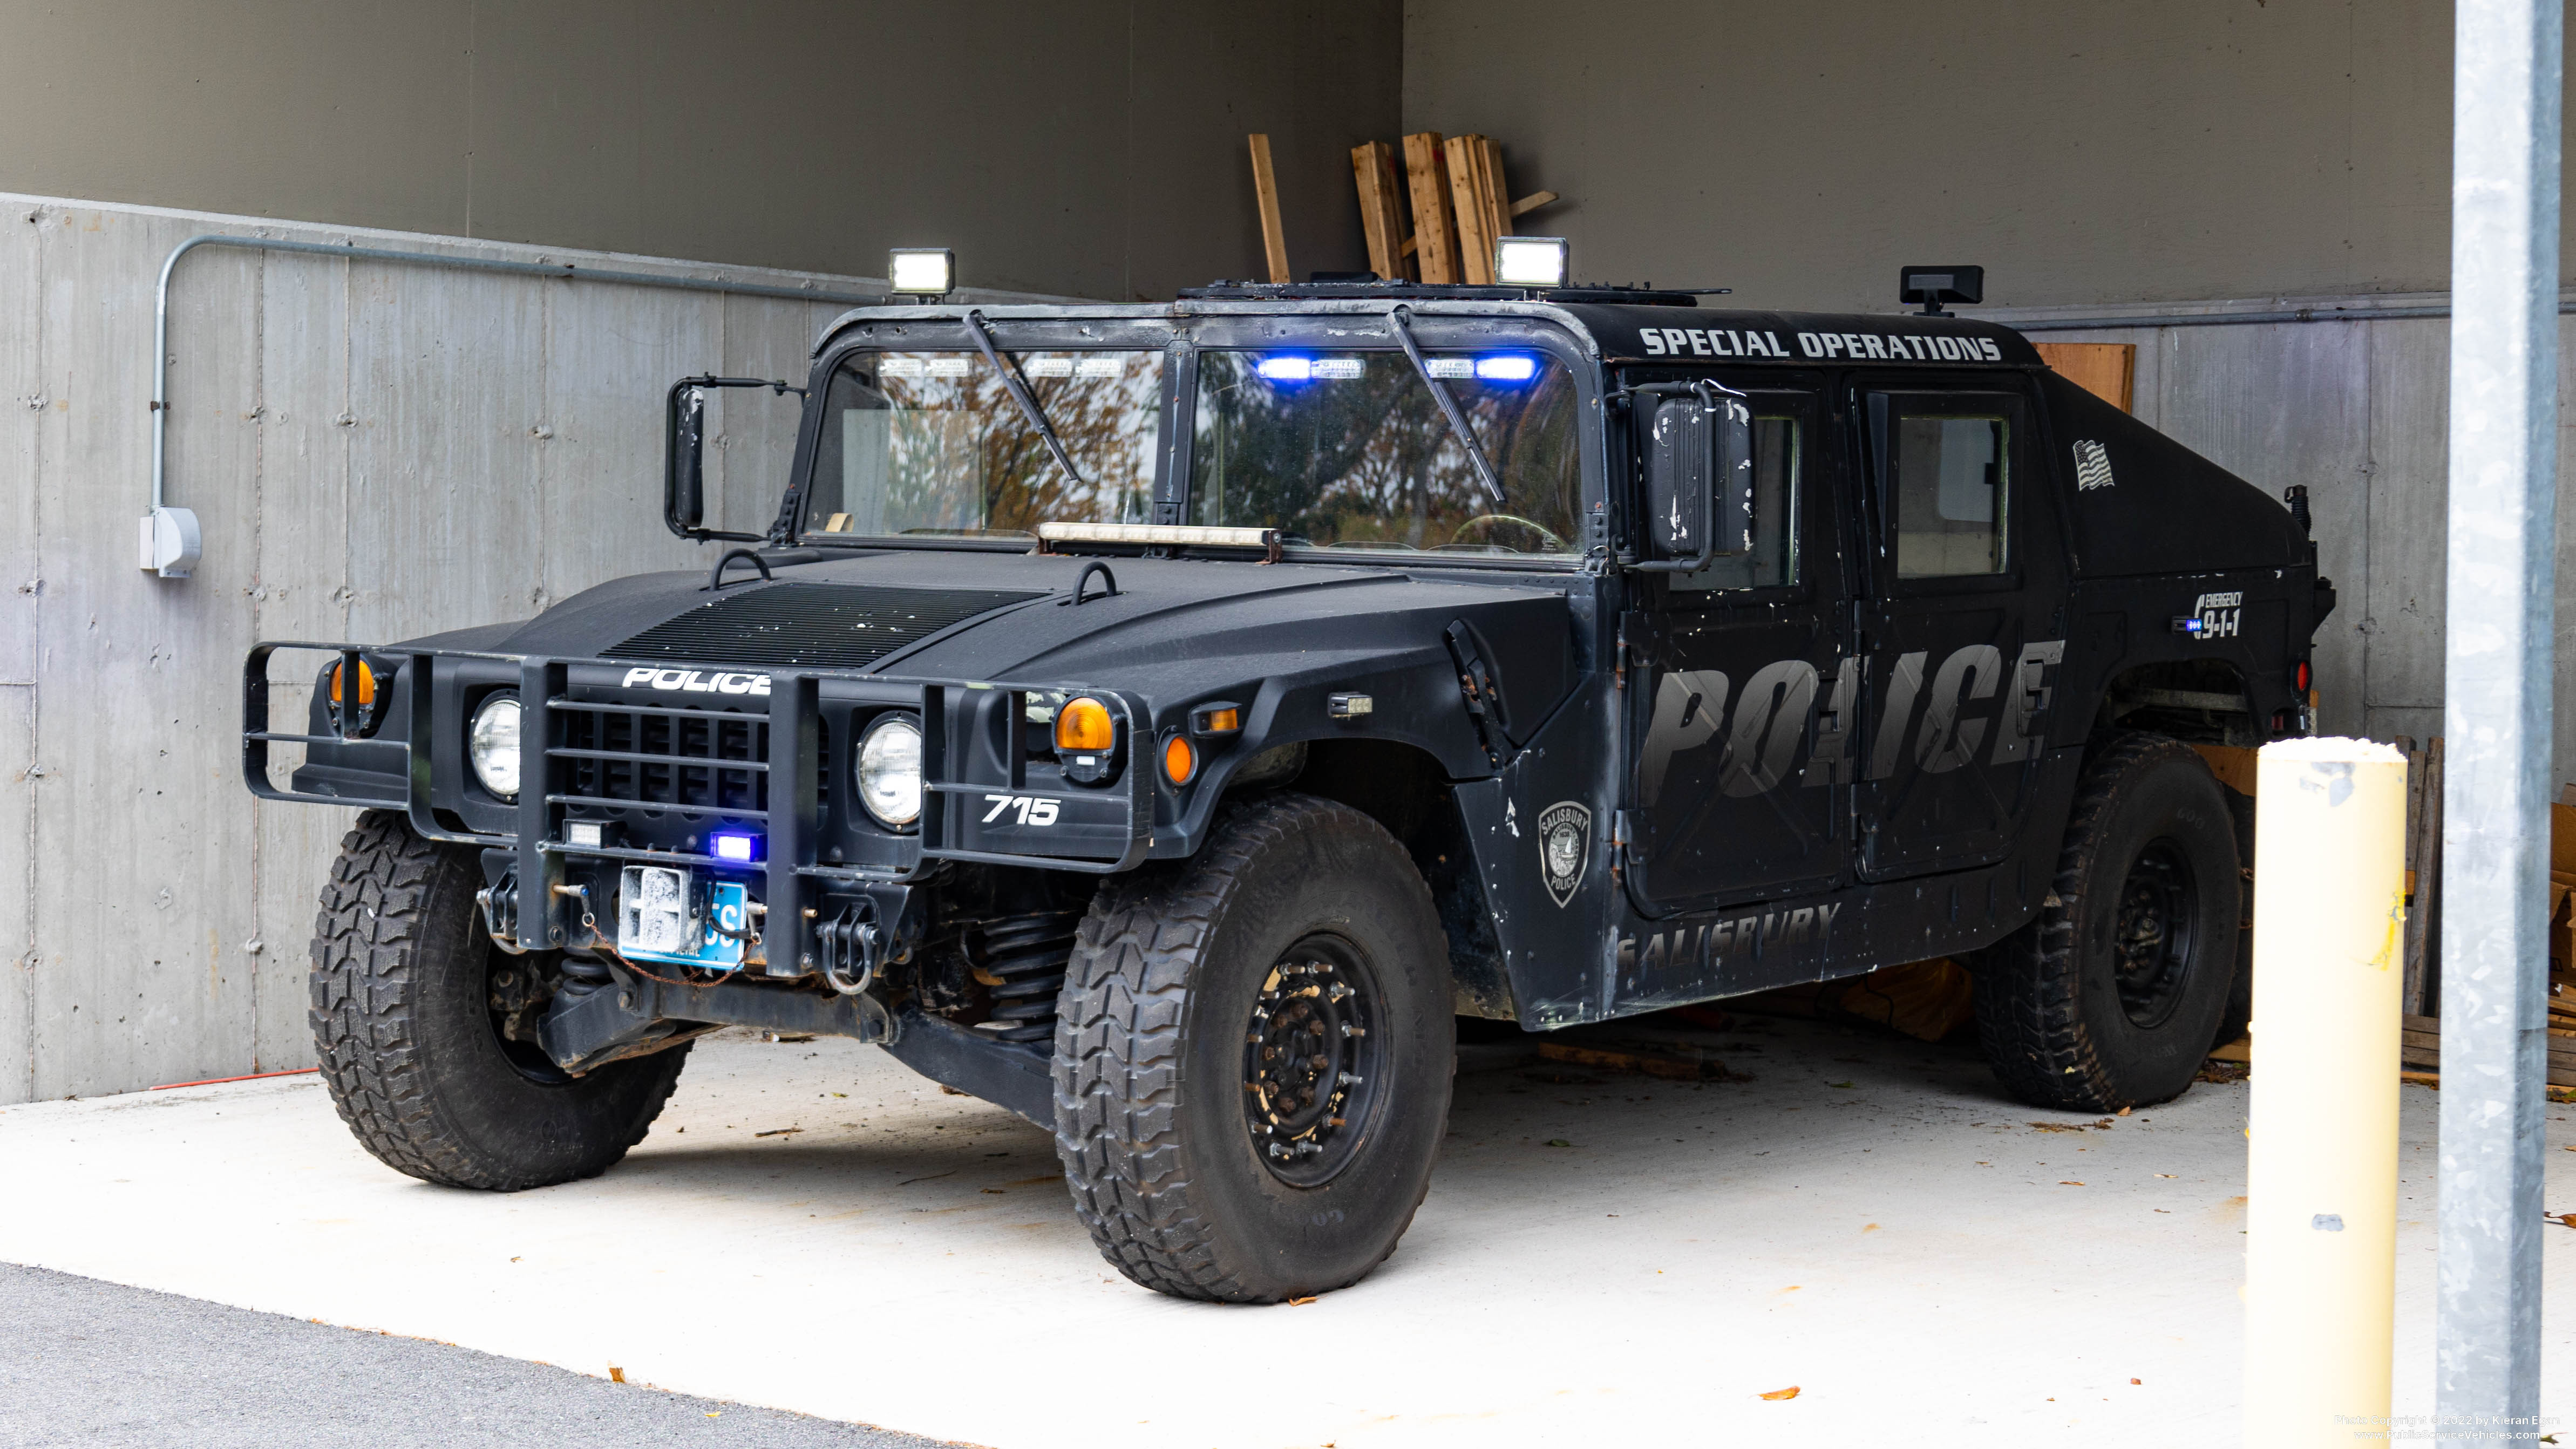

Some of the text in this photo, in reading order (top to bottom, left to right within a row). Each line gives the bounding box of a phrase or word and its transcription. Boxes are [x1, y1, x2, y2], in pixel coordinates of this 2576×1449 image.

[1639, 328, 2002, 360] SPECIAL OPERATIONS
[2205, 591, 2243, 608] EMERGENCY
[2202, 608, 2240, 639] 9-1-1
[622, 667, 771, 696] POLICE
[1632, 640, 2066, 808] POLICE
[981, 794, 1062, 826] 715
[1541, 808, 1588, 835] SALISBURY
[1551, 873, 1576, 890] POLICE
[1616, 902, 1842, 972] SALISBURY
